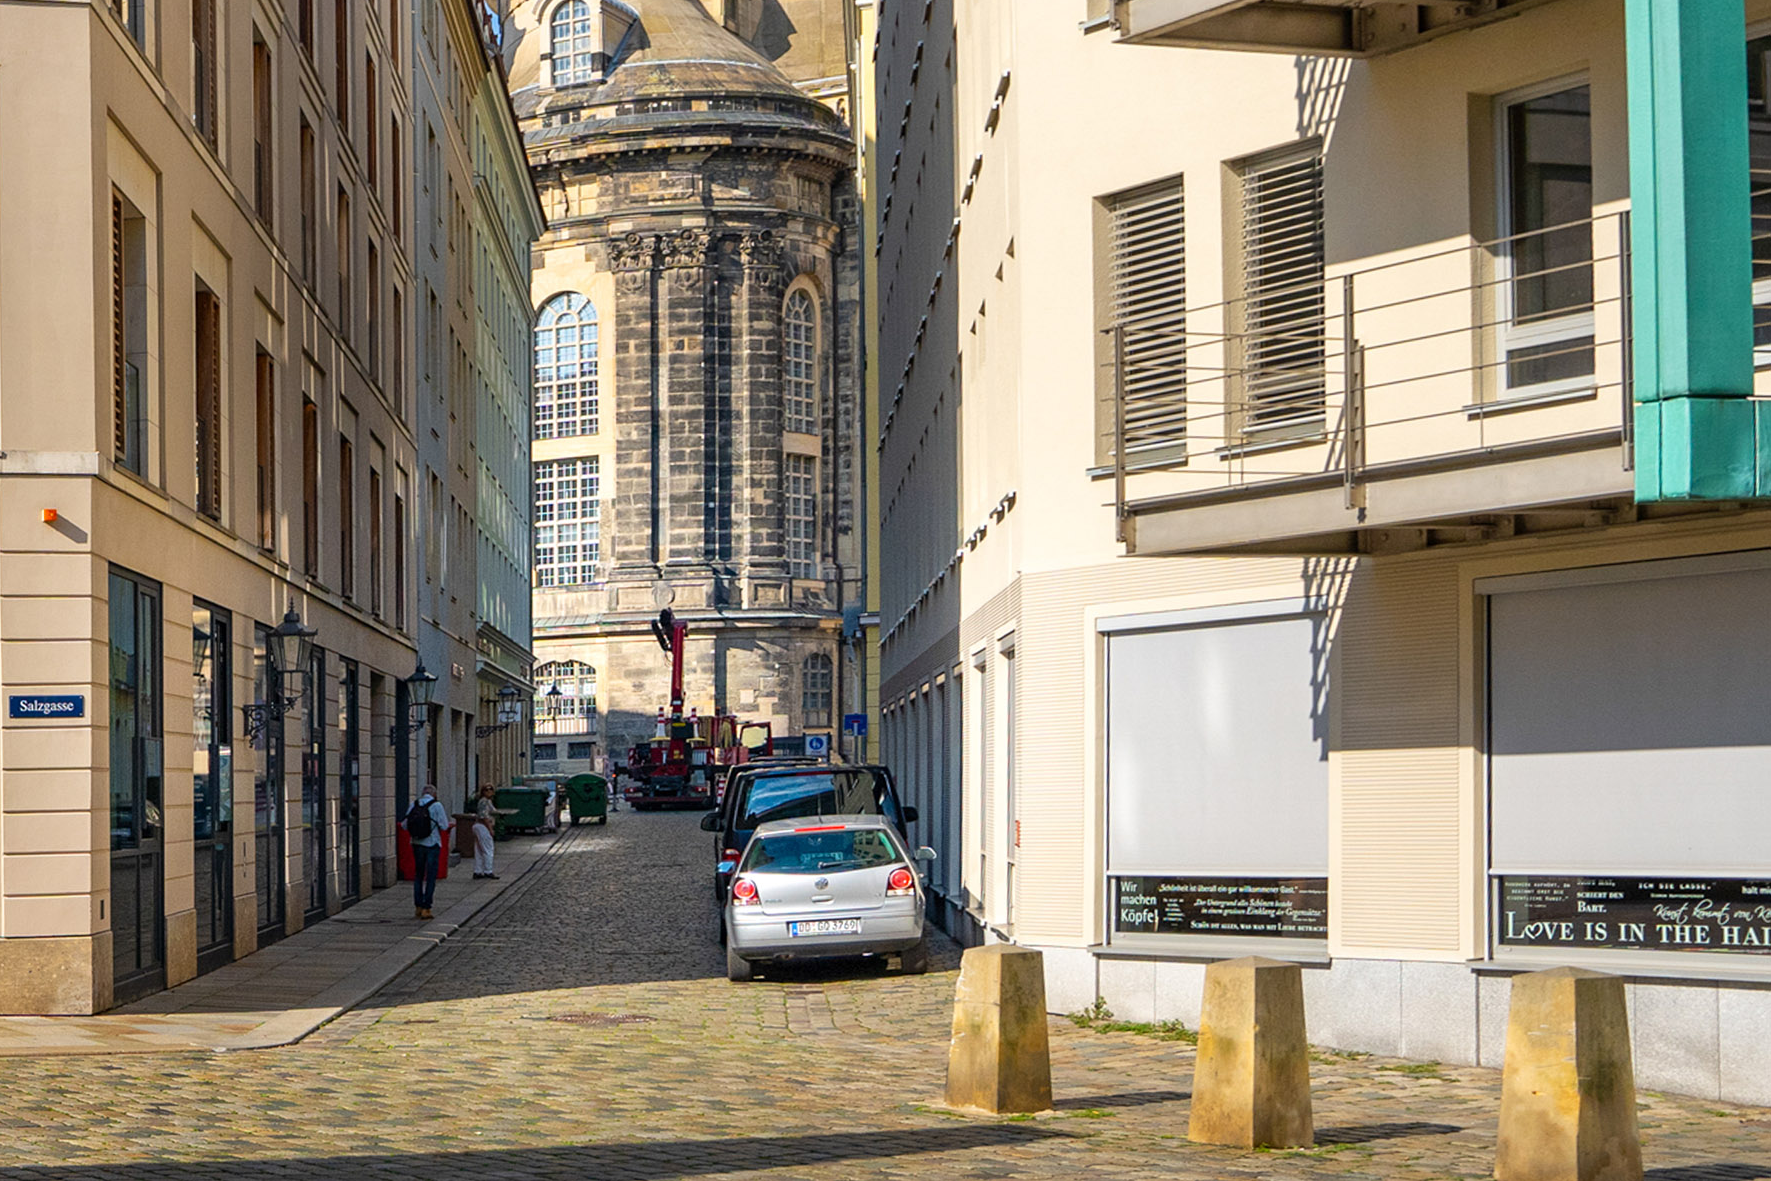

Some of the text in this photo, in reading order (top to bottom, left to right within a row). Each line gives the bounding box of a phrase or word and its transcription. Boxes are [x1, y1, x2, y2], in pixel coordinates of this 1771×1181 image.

[19, 699, 75, 715] Salzgasse
[1120, 881, 1138, 892] Wir
[1120, 894, 1157, 905] machen
[1584, 922, 1608, 941] IS
[1618, 923, 1646, 942] IN
[1655, 924, 1711, 944] THE
